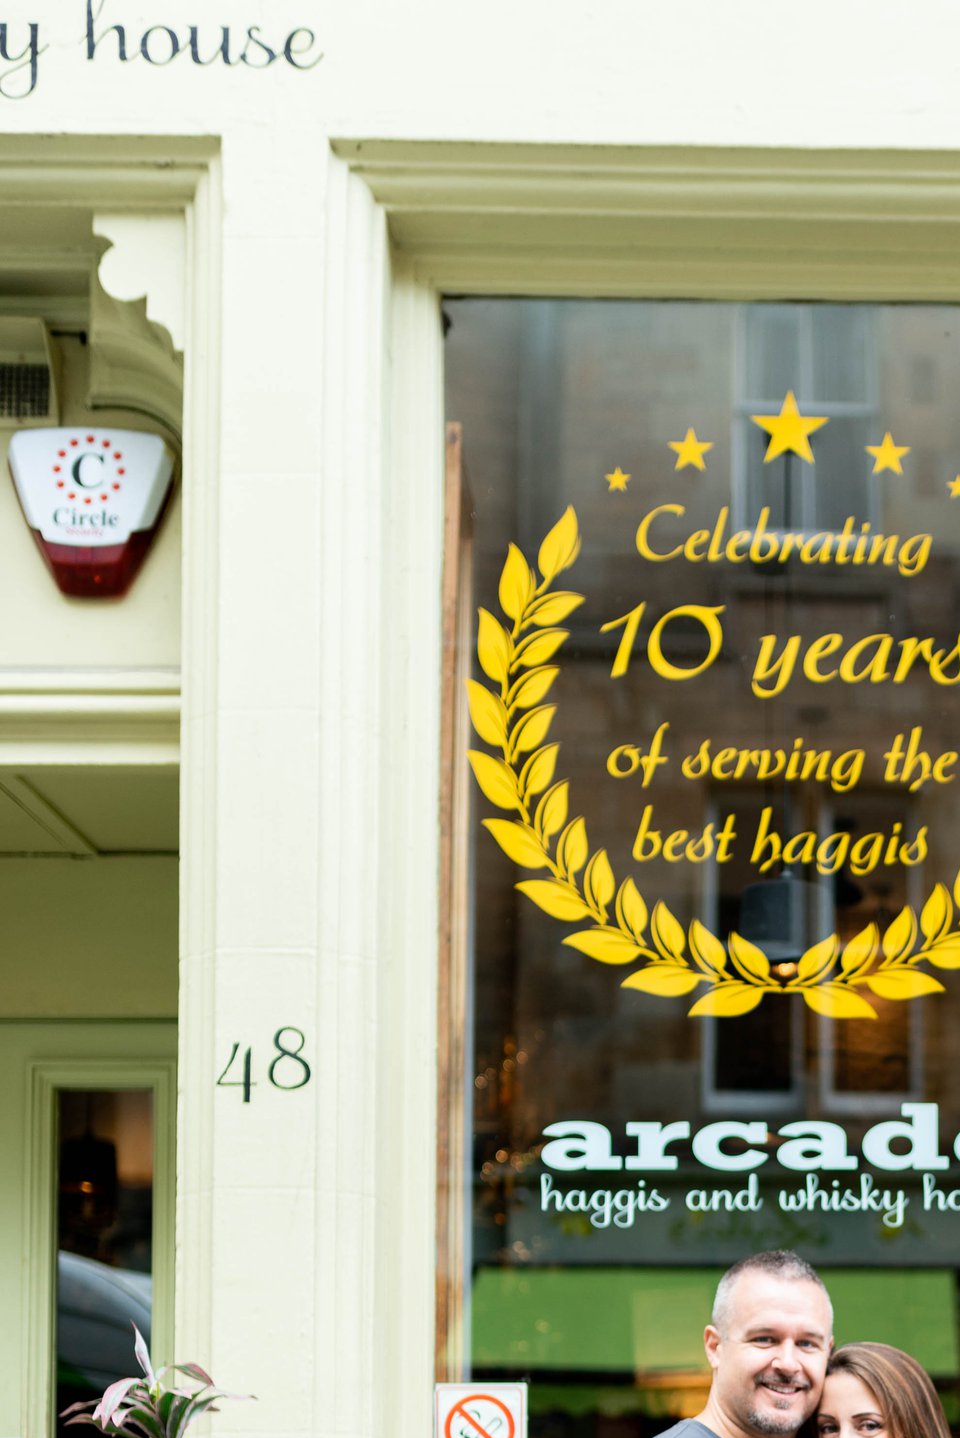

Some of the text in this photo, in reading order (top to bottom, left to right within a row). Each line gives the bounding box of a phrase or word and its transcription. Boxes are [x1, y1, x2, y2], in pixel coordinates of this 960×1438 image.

[79, 0, 325, 70] house
[52, 507, 120, 528] Circle
[635, 504, 933, 577] Celebrating
[599, 601, 727, 682] 10
[606, 721, 959, 792] of serving the
[631, 804, 929, 876] best haggis
[217, 1026, 312, 1104] 48
[540, 1173, 670, 1228] haggis
[685, 1173, 762, 1211] and
[778, 1173, 907, 1228] whisky
